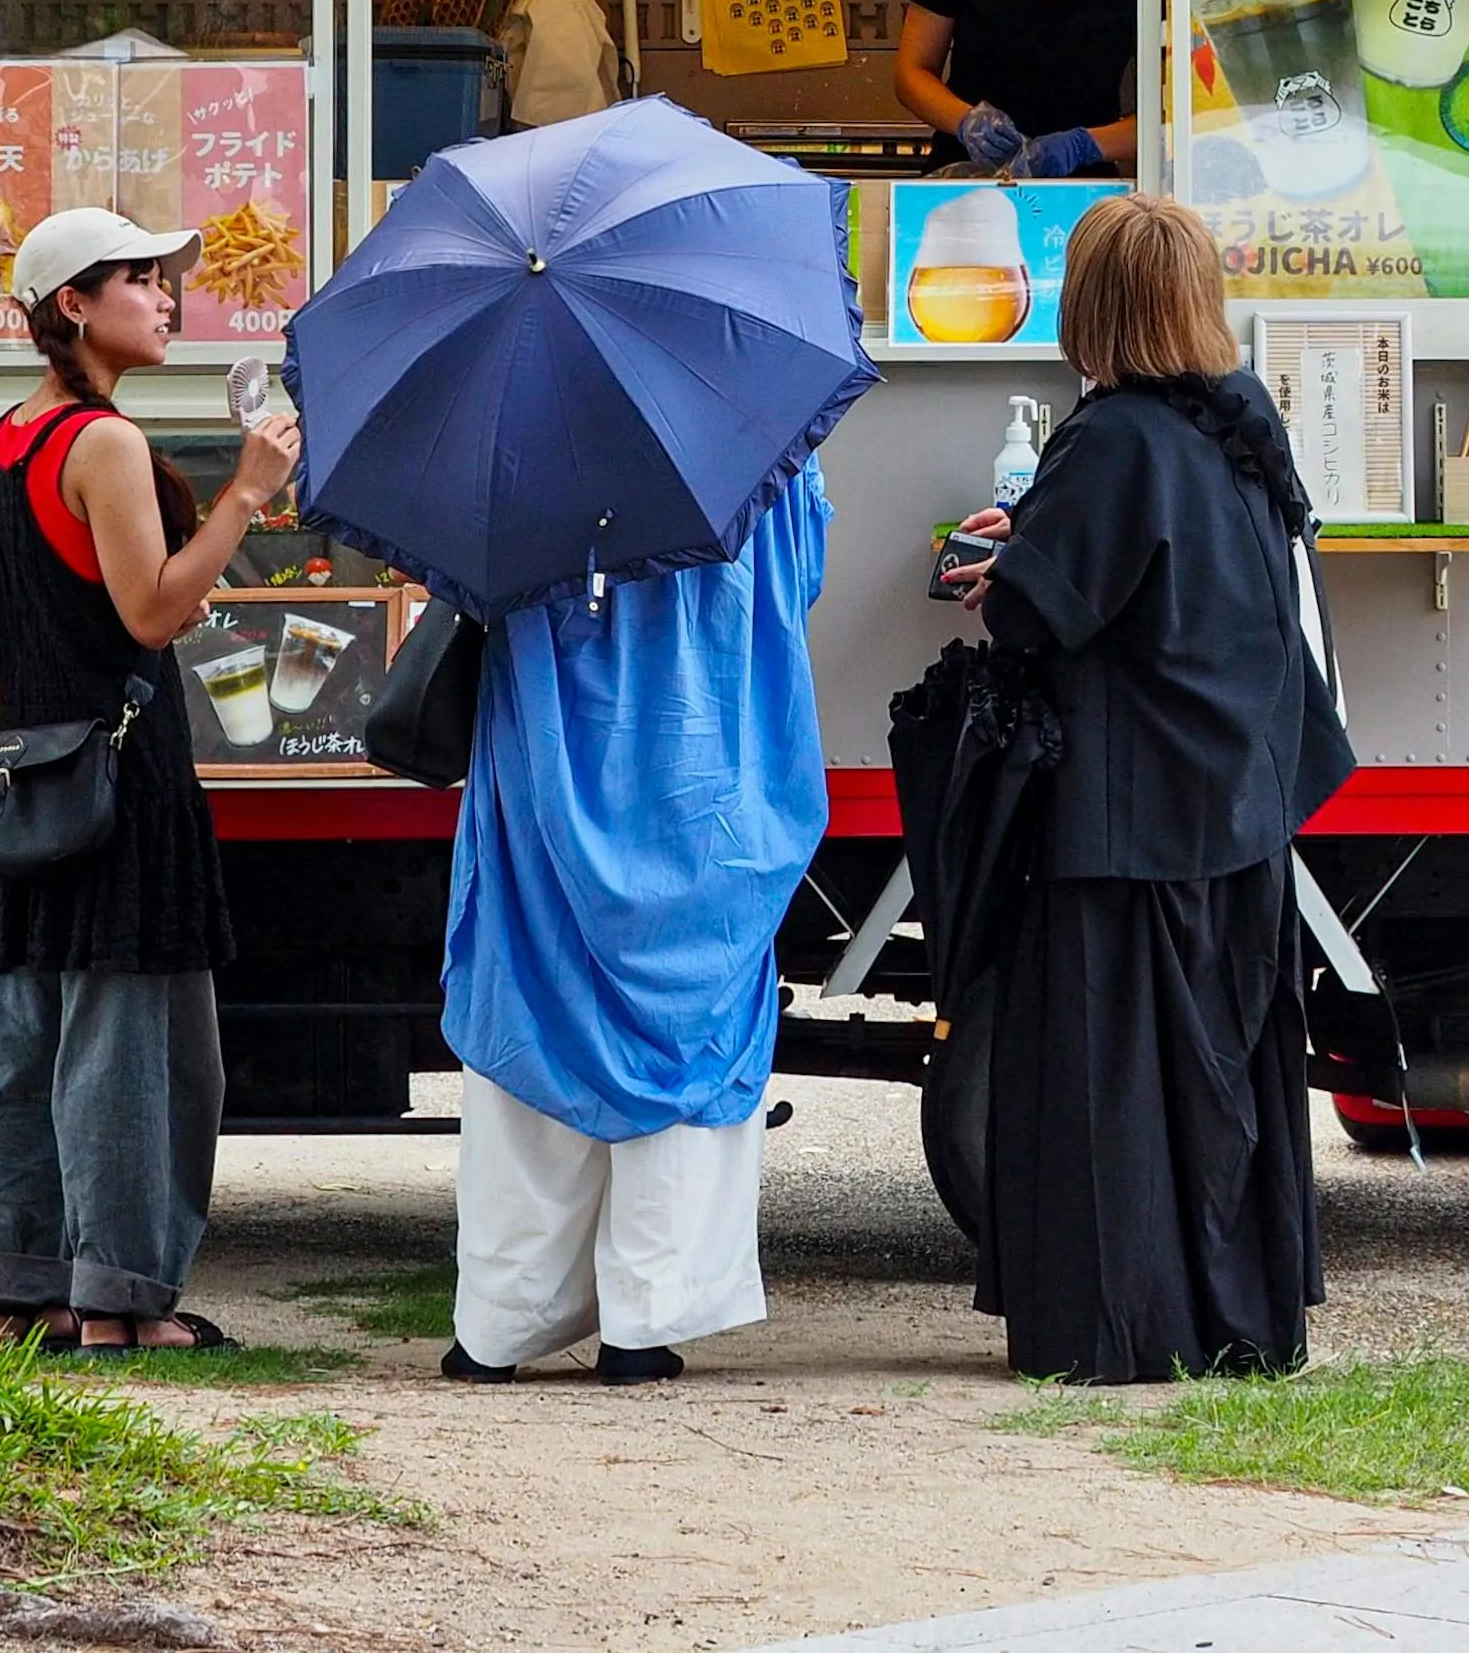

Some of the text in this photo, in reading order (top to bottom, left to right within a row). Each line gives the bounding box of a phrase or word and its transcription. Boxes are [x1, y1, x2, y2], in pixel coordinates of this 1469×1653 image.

[192, 131, 298, 158] フライド
[65, 145, 169, 174] からあげ
[204, 163, 282, 189] ポテト
[1043, 225, 1067, 249] 冷
[1367, 257, 1423, 276] ¥600
[1377, 337, 1389, 413] 本日のお米は
[1320, 351, 1340, 506] 茨城県産コシヒカリ
